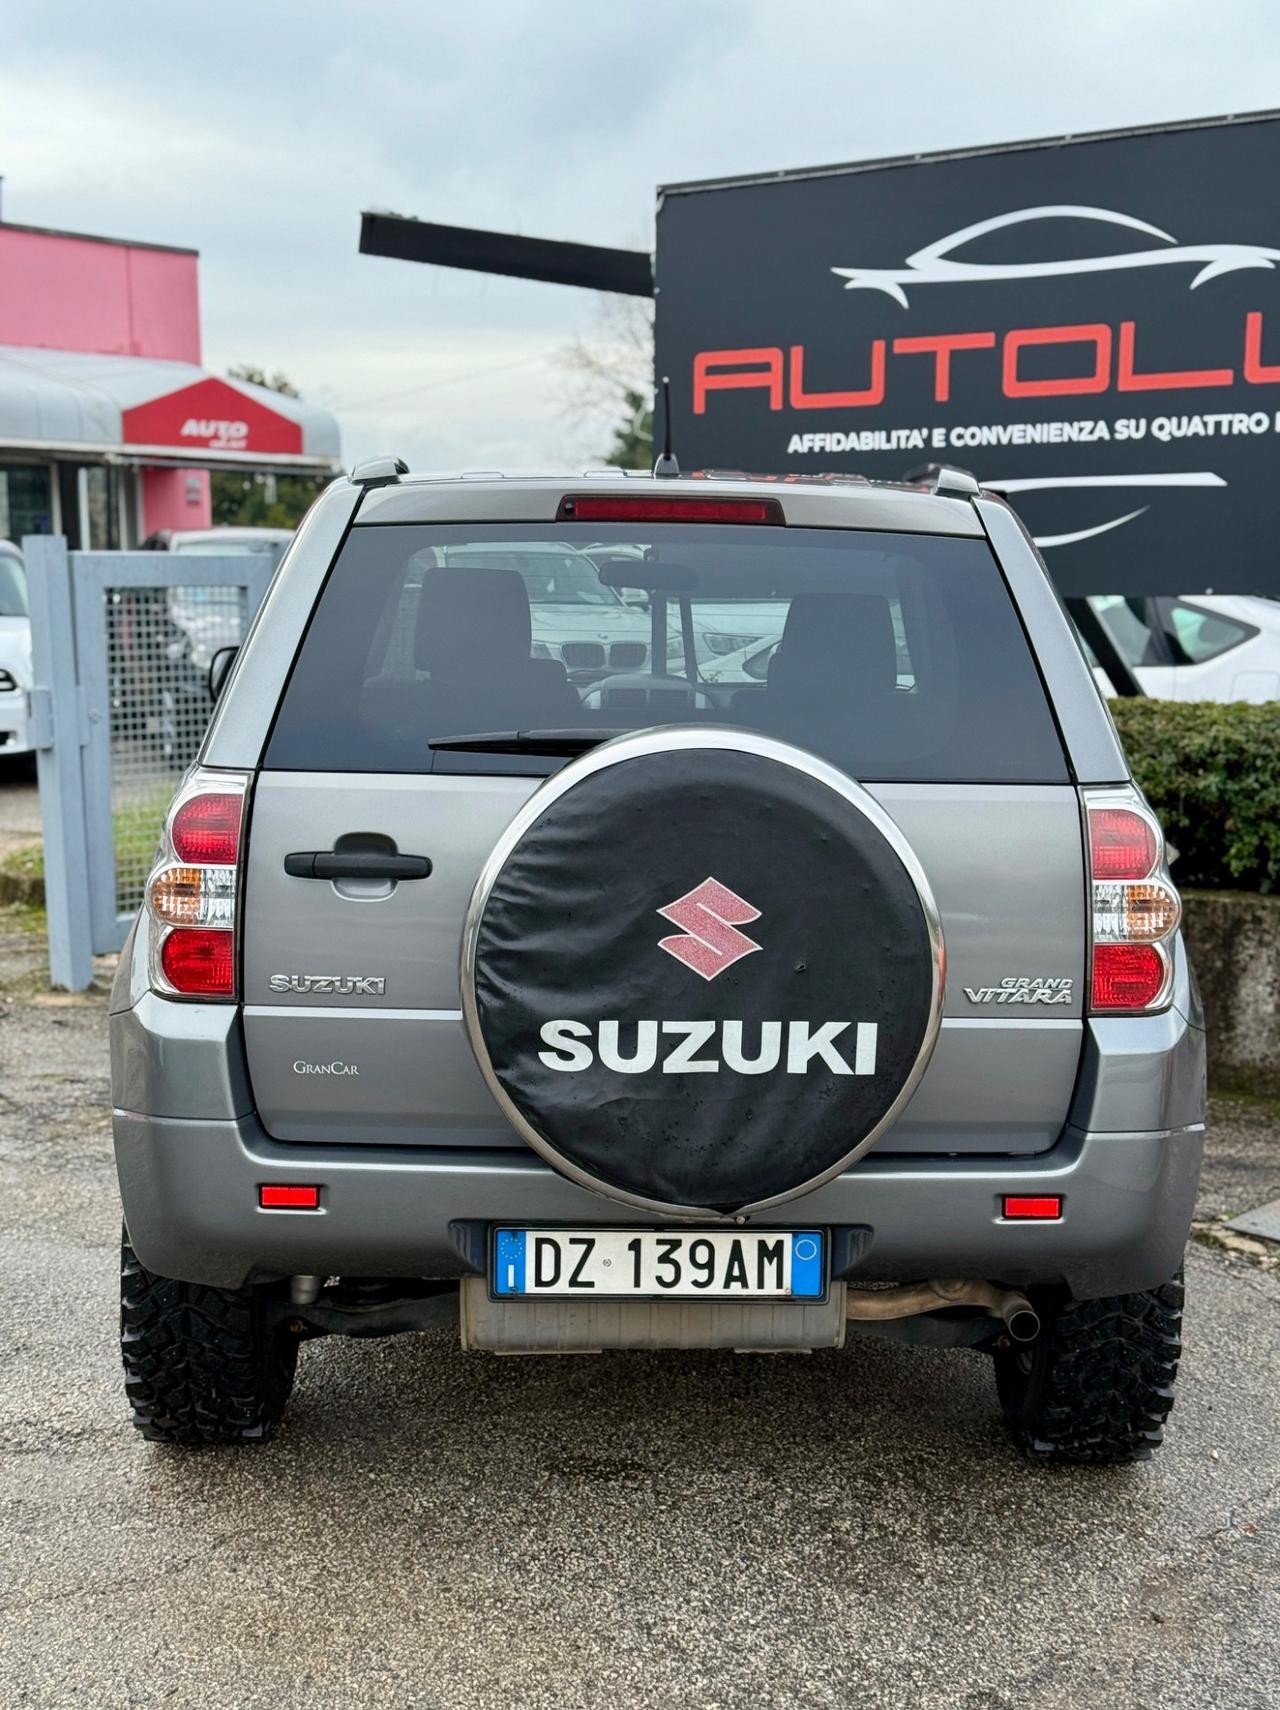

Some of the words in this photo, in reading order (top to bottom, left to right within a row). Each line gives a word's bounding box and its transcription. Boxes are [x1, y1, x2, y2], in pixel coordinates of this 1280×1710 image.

[180, 419, 249, 438] AUTO
[932, 428, 946, 448] E
[950, 421, 1111, 447] CONVENIENZA
[1114, 418, 1147, 440] SU
[1151, 411, 1270, 442] QUATTRO
[269, 974, 386, 995] SUZUKI
[1001, 978, 1073, 988] GRAND
[964, 988, 1072, 1004] VITARA
[538, 1019, 878, 1075] SUZUKI
[534, 1237, 596, 1288] DZ
[627, 1238, 785, 1290] 139AM
